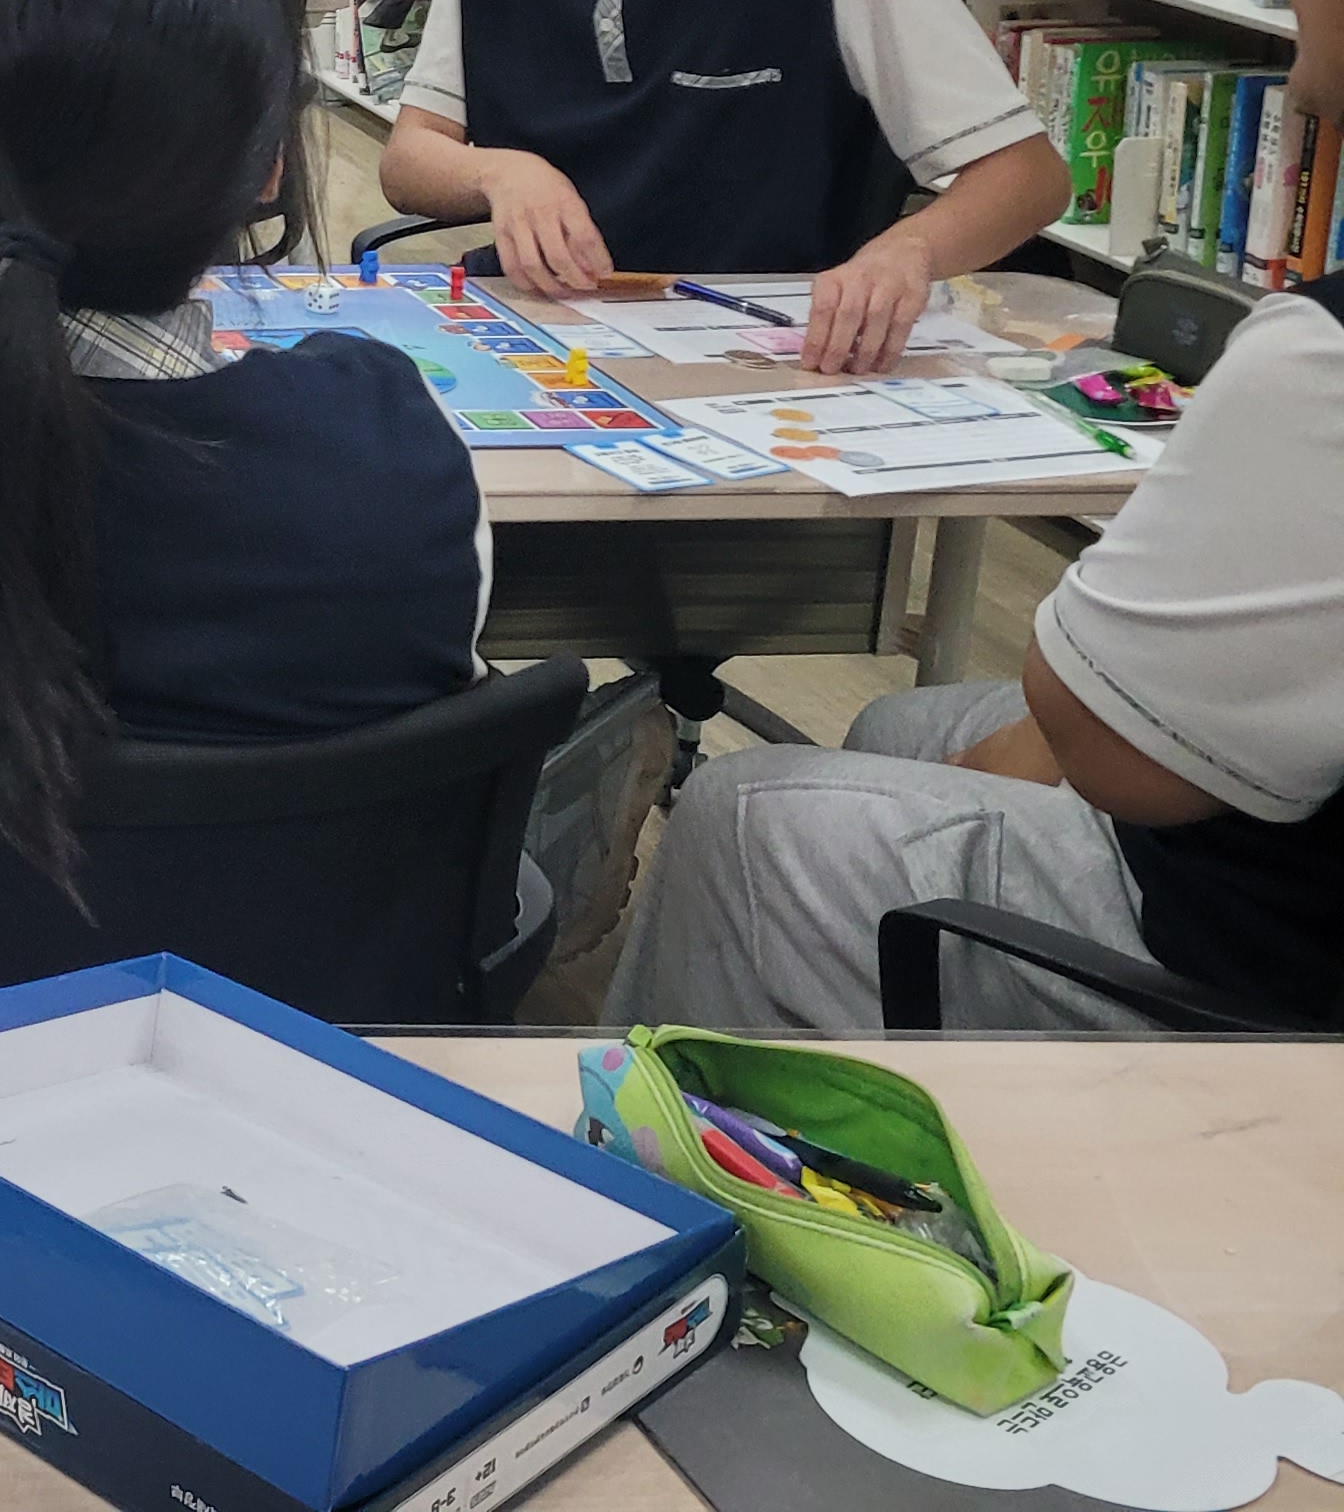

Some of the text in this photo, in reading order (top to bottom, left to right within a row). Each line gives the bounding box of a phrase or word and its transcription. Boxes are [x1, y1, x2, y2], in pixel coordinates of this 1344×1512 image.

[997, 1349, 1128, 1432] 금융교육으로 만드는
[475, 1457, 497, 1479] 12+
